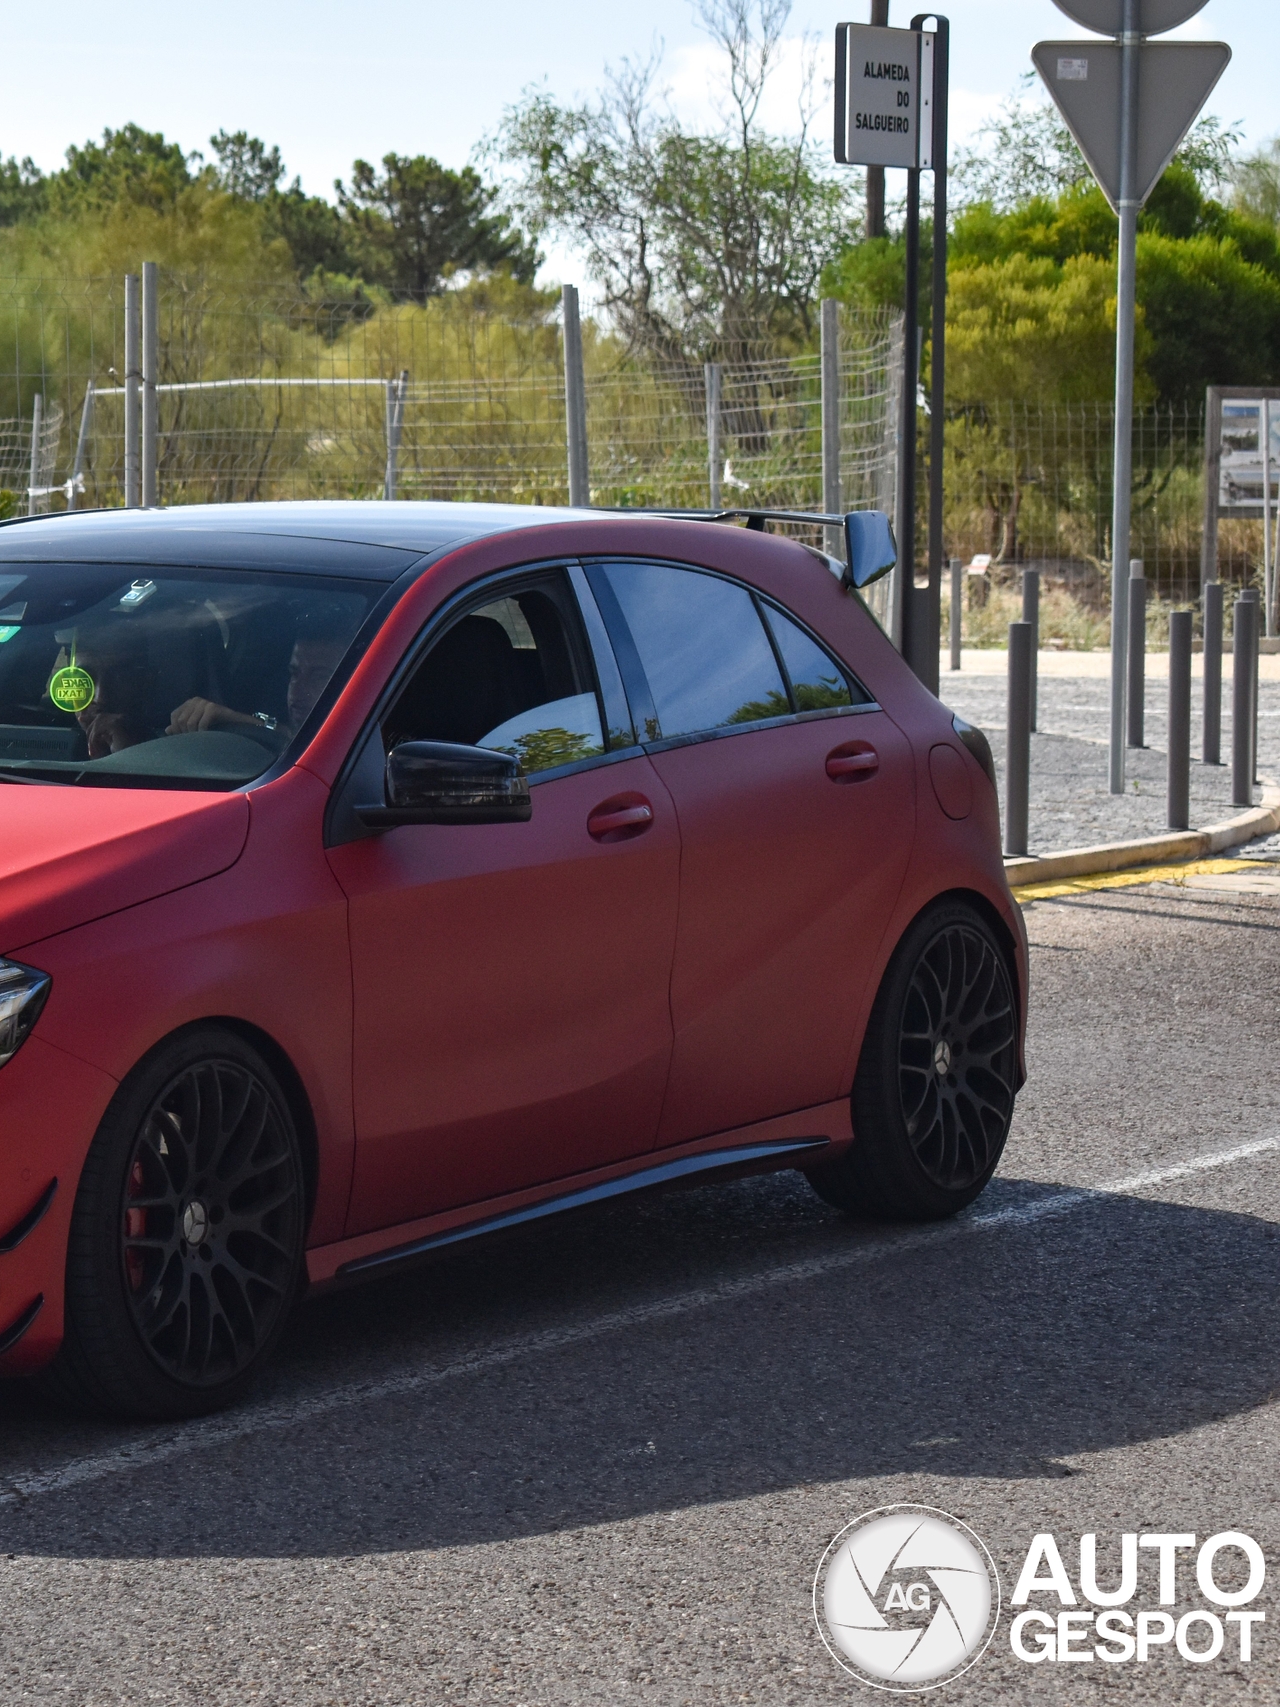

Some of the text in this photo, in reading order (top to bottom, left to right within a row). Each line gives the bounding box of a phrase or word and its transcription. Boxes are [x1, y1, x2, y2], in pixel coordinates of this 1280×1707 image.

[864, 62, 910, 81] ALAMEDA
[897, 91, 909, 107] DO
[856, 113, 909, 133] SALGUEIRO
